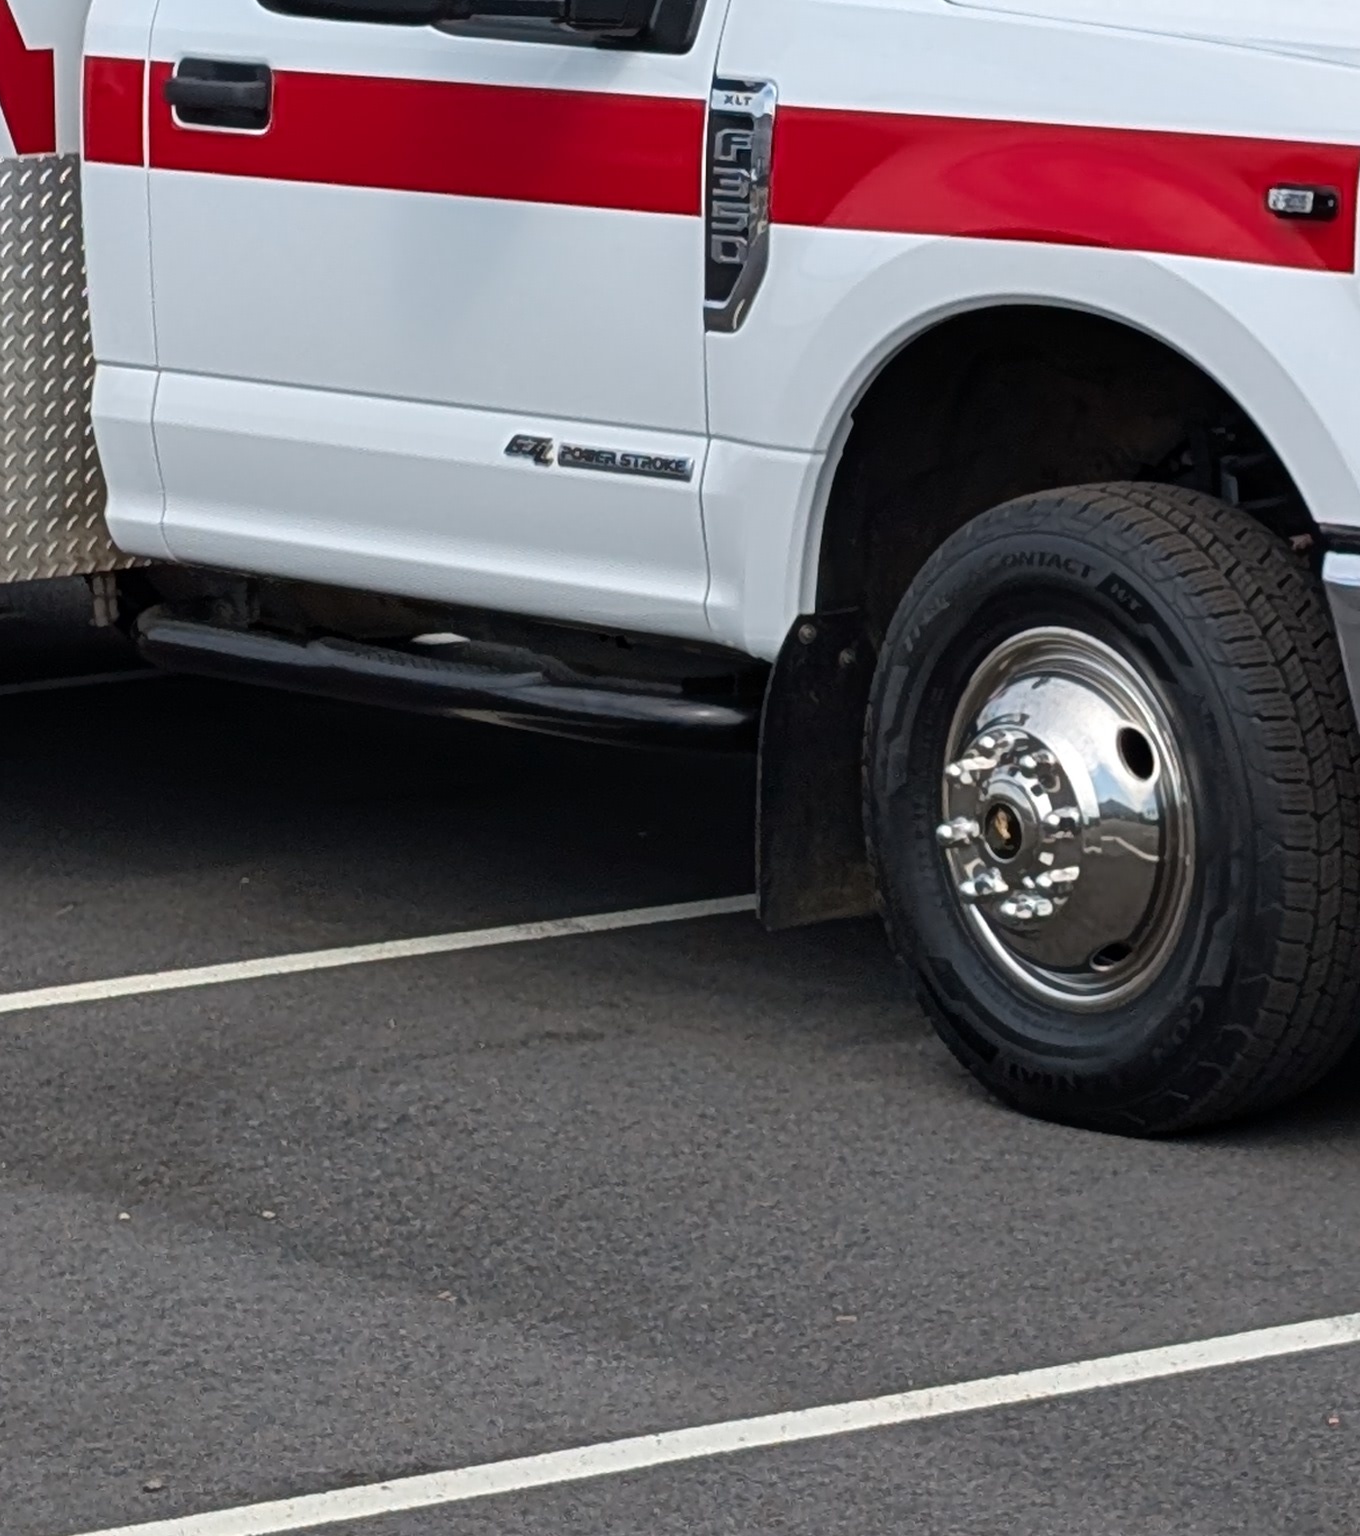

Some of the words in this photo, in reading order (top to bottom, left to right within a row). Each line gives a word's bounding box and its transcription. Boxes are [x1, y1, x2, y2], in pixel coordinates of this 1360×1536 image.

[723, 94, 753, 107] XLT
[560, 444, 617, 465] POWER
[619, 452, 687, 474] STROKE
